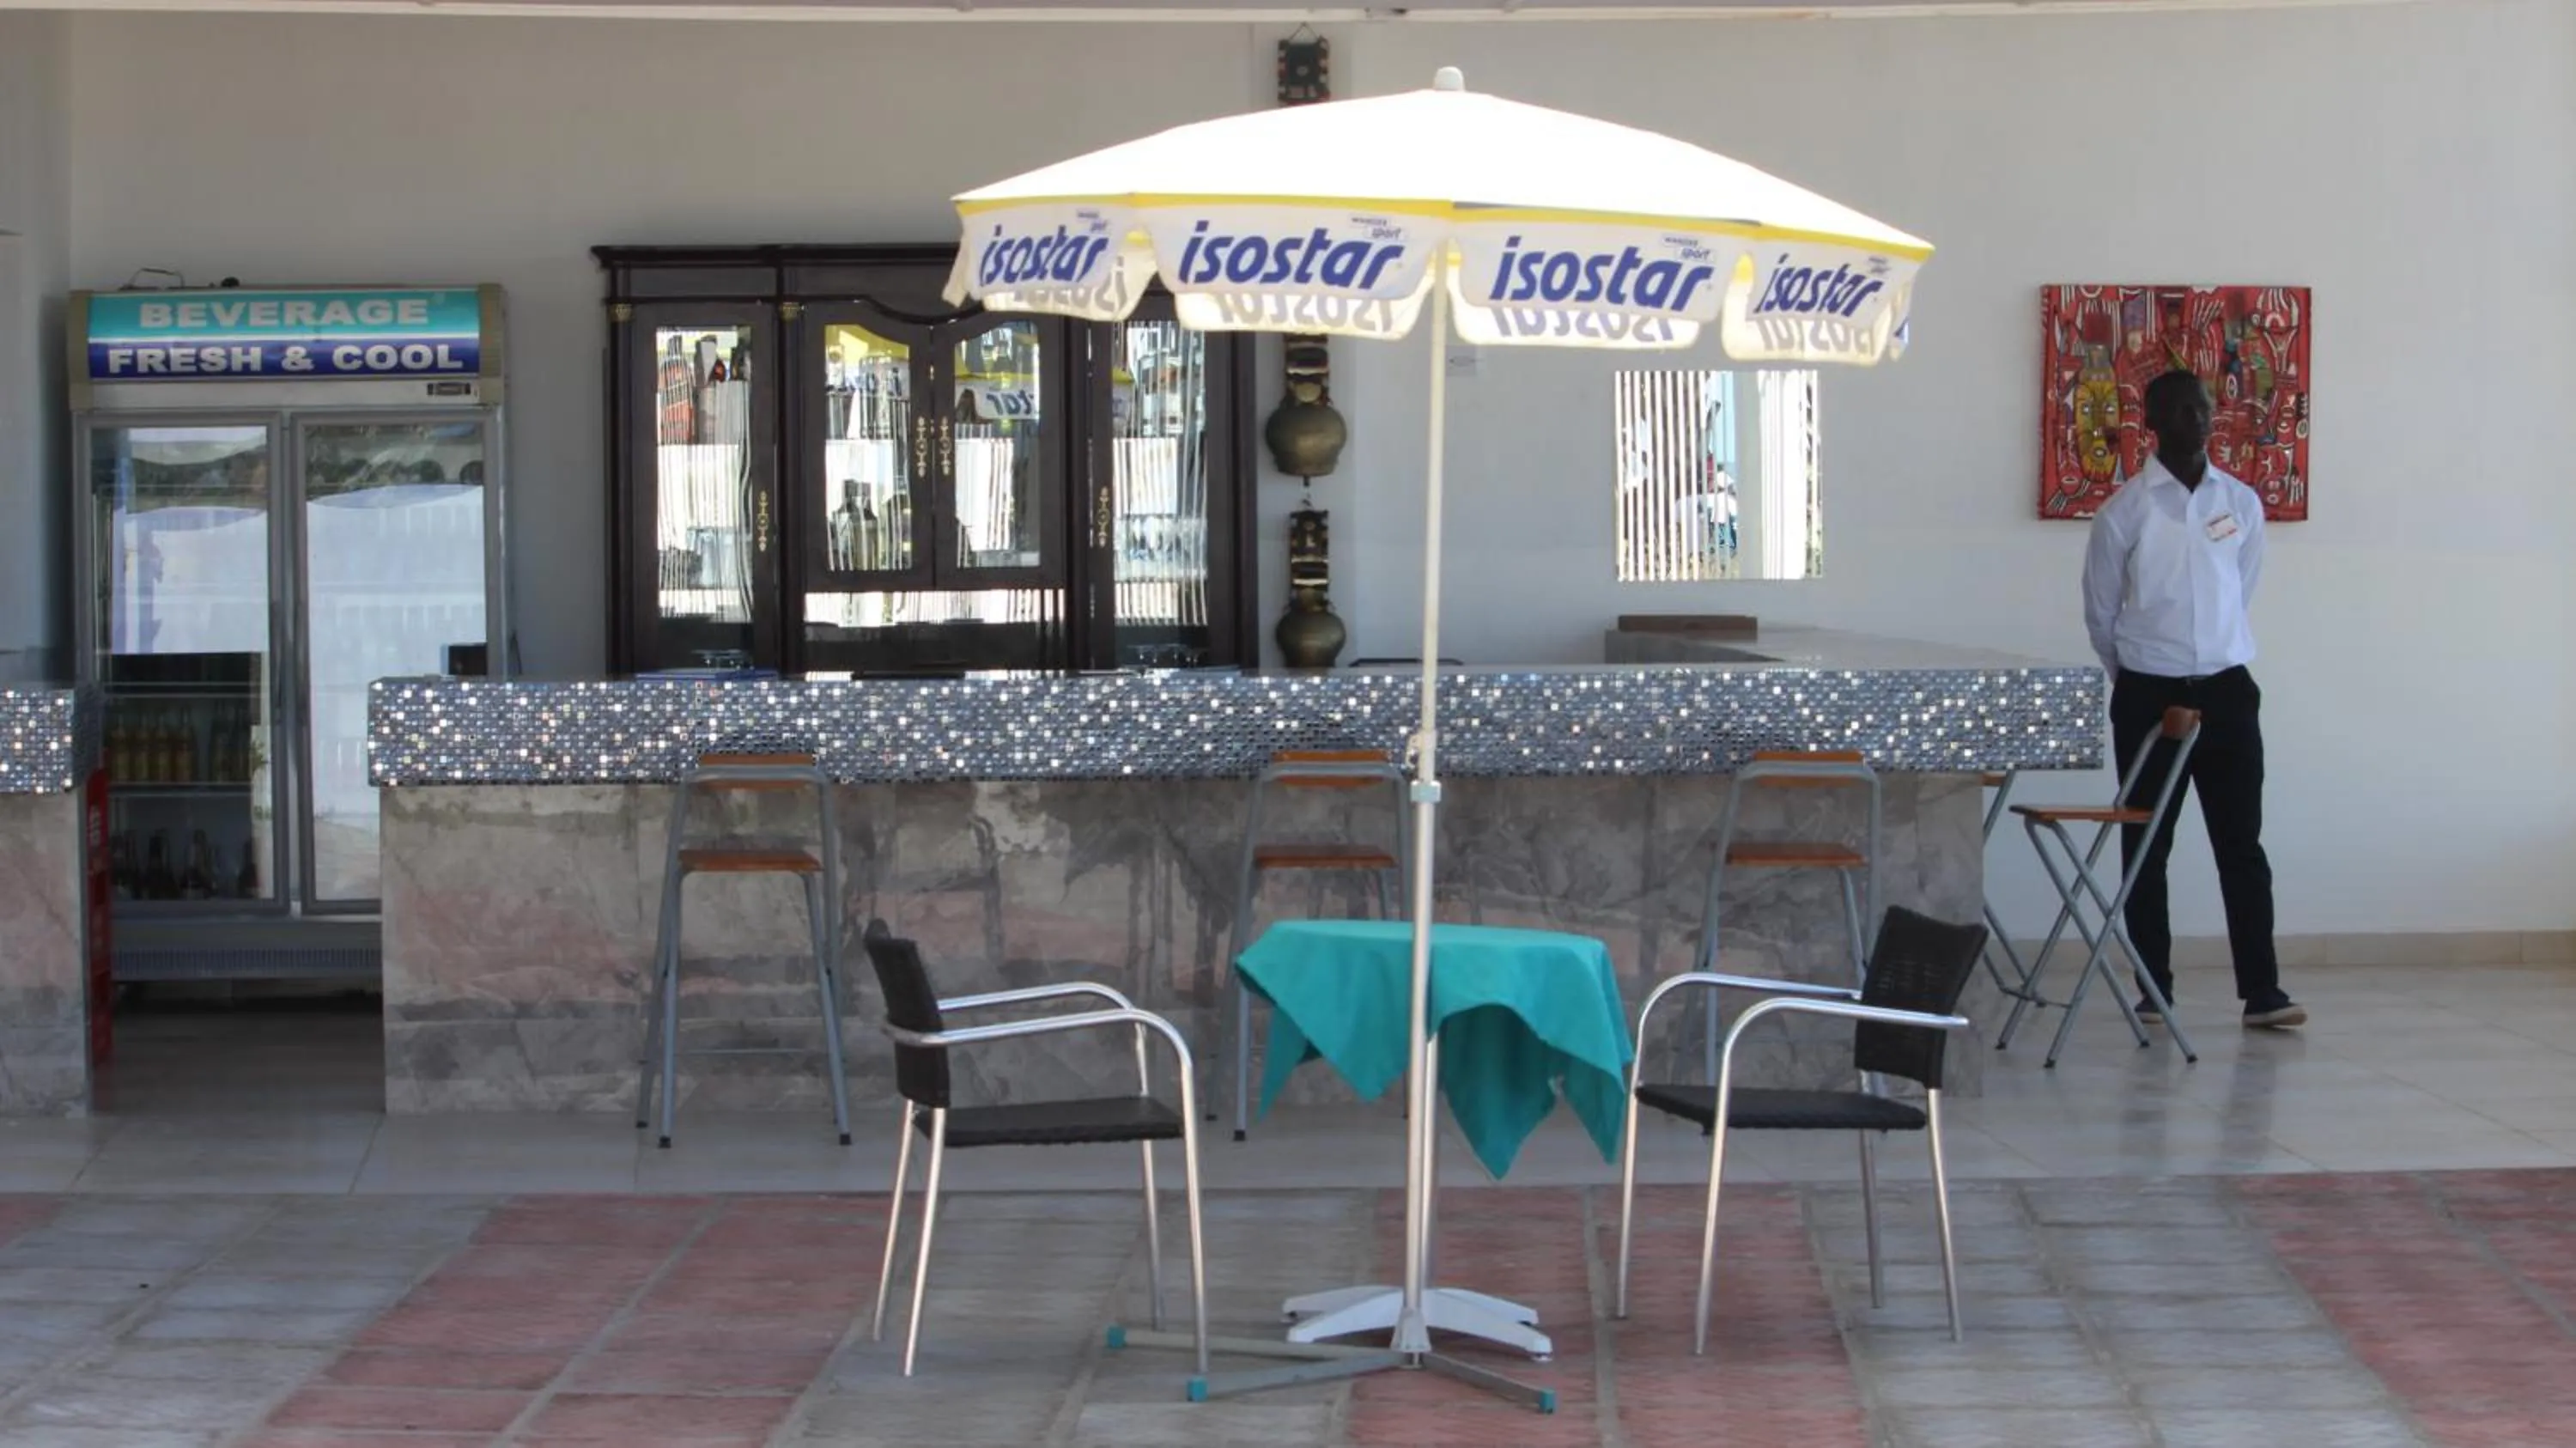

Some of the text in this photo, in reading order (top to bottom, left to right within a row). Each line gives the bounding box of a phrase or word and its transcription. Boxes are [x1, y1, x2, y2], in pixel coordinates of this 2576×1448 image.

[980, 224, 1109, 286] isostar
[1178, 221, 1406, 290] isostar
[1489, 235, 1714, 312] isostar
[1753, 252, 1883, 318] isostar
[139, 298, 429, 329] BEVERAGE
[107, 344, 463, 374] FRESH & COOL
